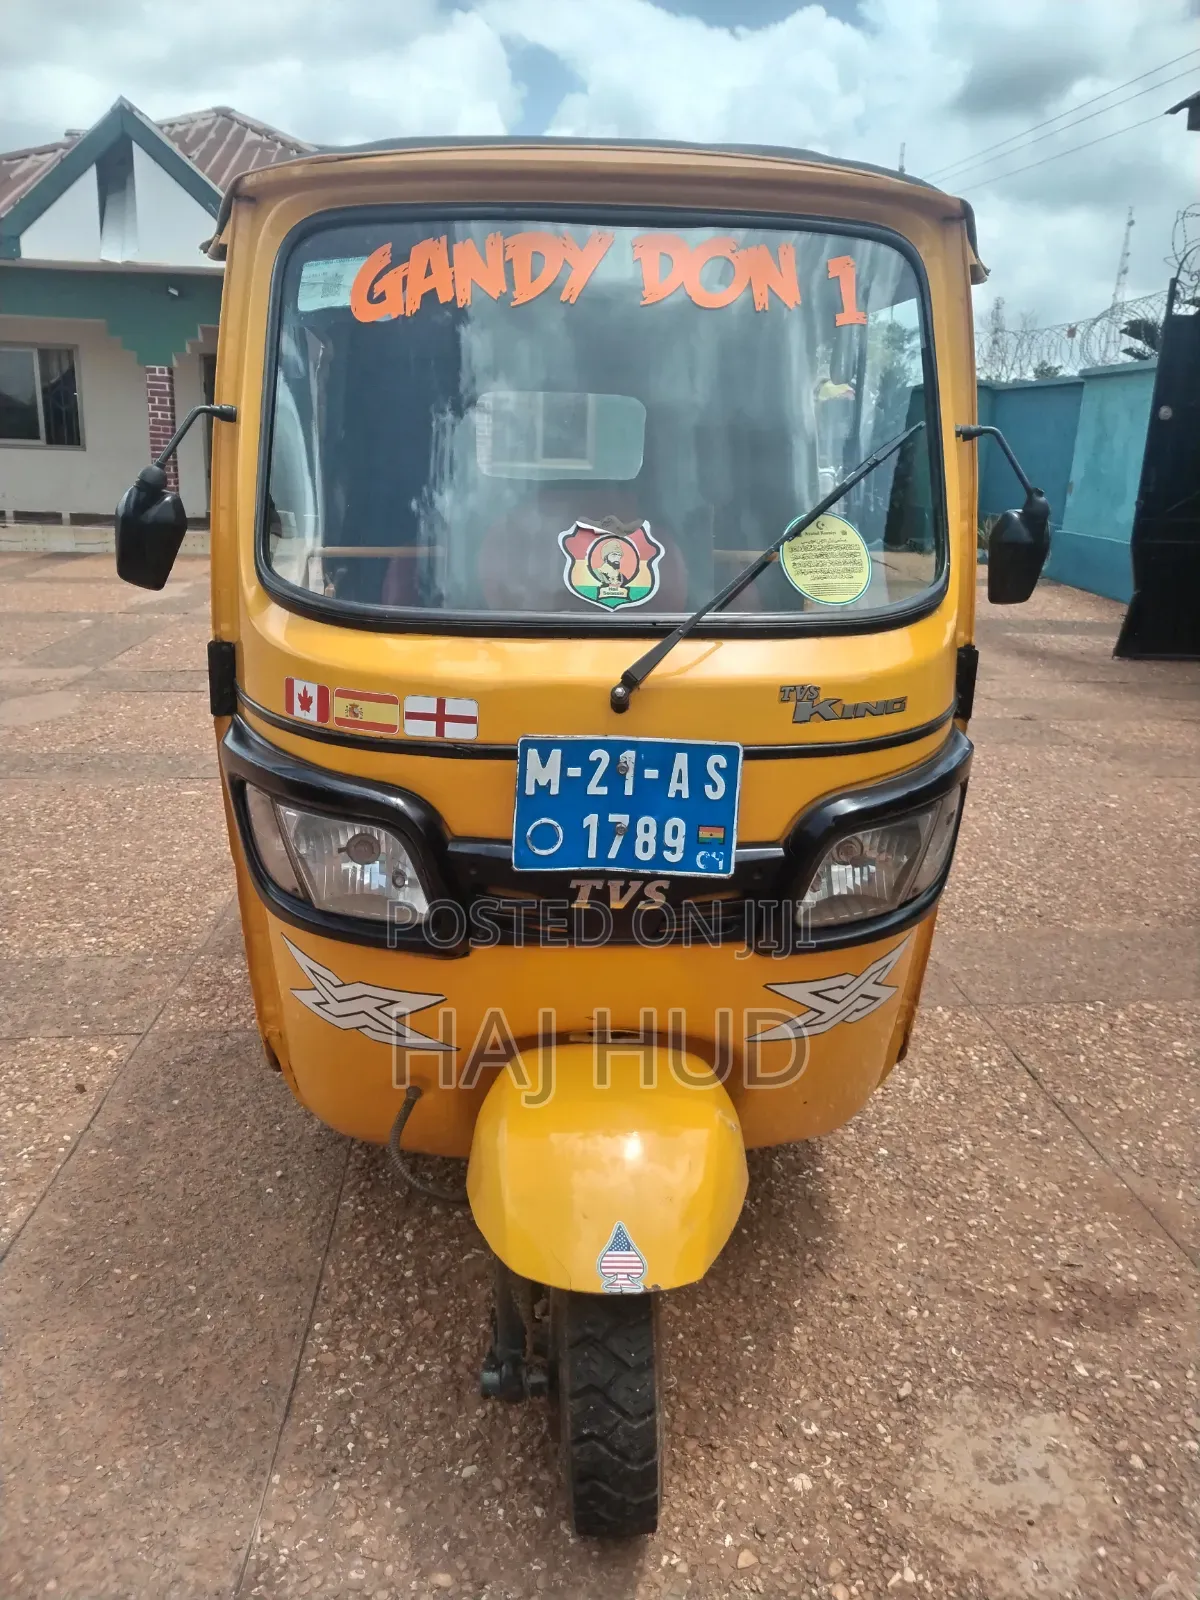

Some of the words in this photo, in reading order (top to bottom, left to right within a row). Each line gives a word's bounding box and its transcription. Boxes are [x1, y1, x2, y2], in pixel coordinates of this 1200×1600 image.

[351, 230, 615, 323] GANDY
[632, 232, 802, 311] DON
[827, 254, 868, 327] 1
[779, 684, 821, 701] TVS
[583, 813, 687, 863] 1789
[569, 879, 671, 909] TVS
